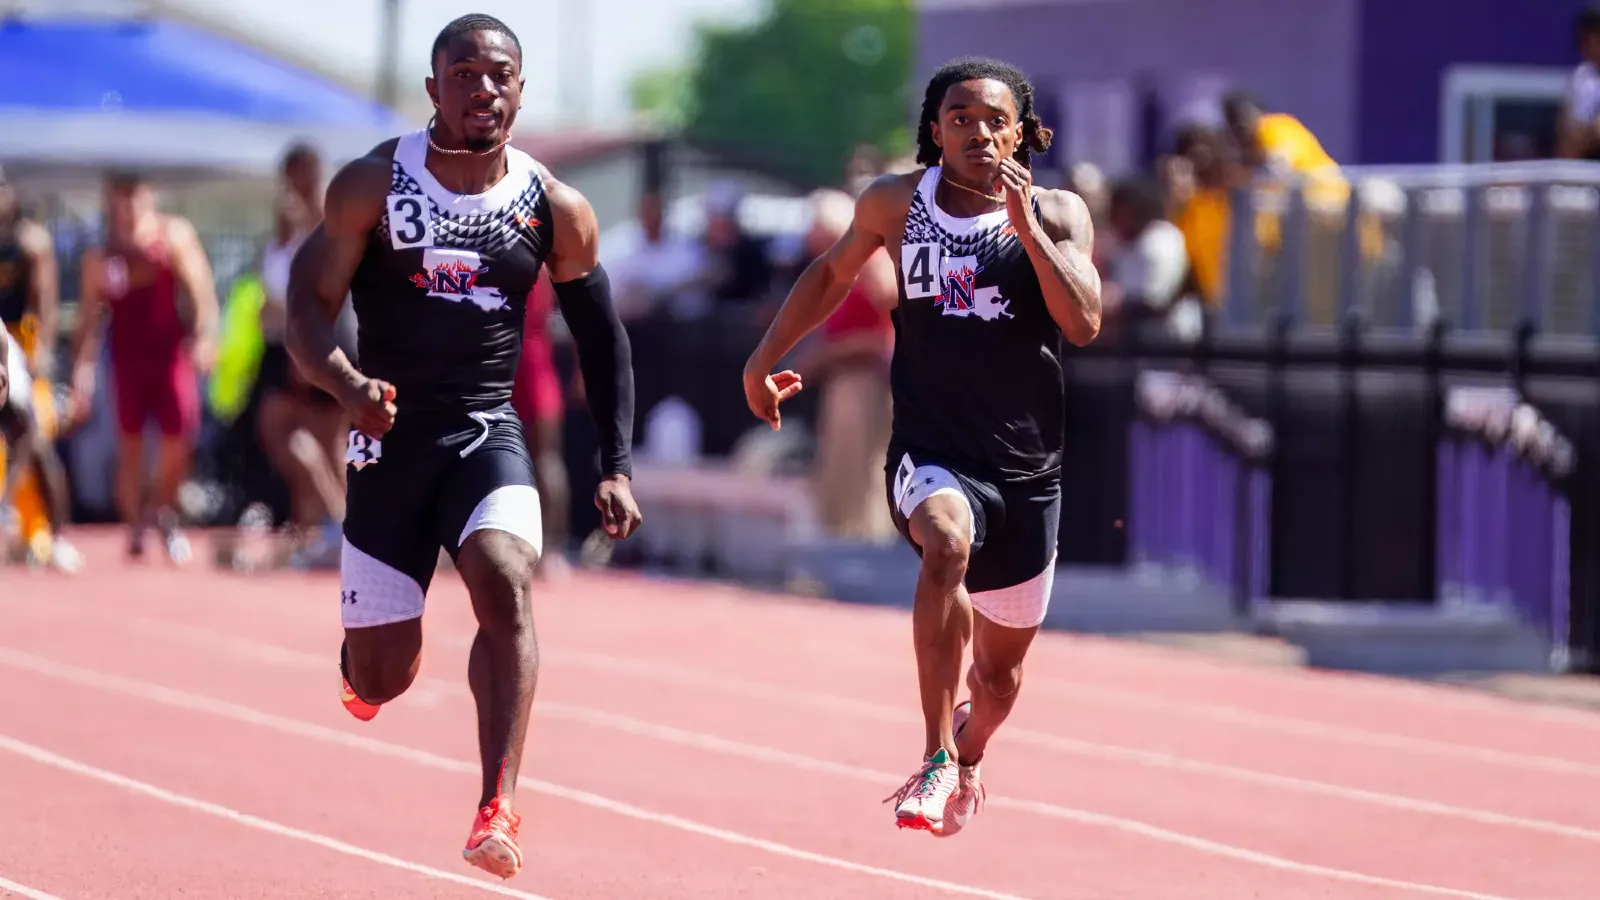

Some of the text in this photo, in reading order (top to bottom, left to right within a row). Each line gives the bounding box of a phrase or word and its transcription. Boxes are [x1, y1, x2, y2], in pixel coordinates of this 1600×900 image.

[394, 198, 426, 244] 3
[433, 269, 474, 295] N
[907, 246, 935, 293] 4
[946, 275, 975, 310] N
[353, 431, 374, 463] 3
